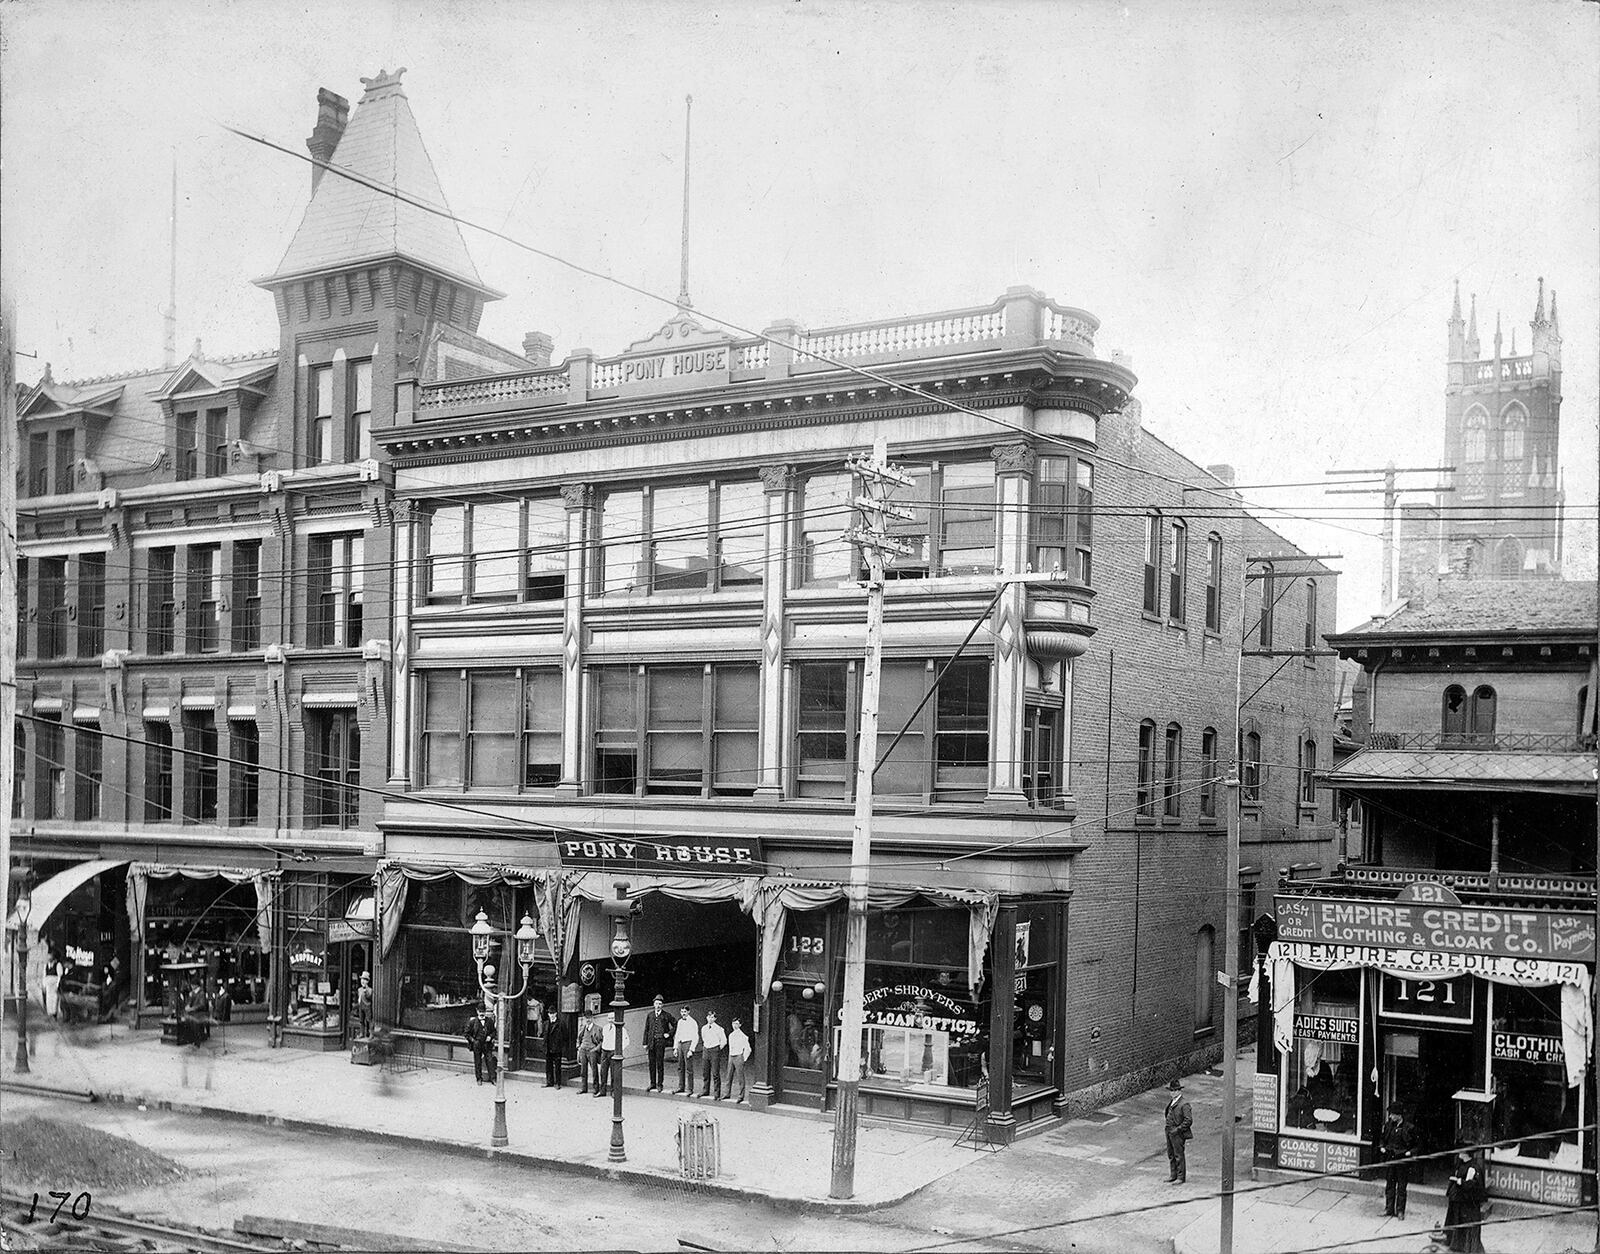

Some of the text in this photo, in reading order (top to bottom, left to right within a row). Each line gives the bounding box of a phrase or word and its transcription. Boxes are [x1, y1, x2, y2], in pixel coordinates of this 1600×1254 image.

[624, 350, 726, 382] PONY HOUSE
[564, 841, 752, 865] PONY HOUSE
[1412, 886, 1444, 902] 121
[1278, 904, 1309, 916] CASH
[1288, 917, 1302, 926] OR
[1322, 904, 1537, 934] EMPIRE CREDIT
[1279, 924, 1313, 938] CREDIT
[1322, 923, 1407, 944] CLOTHING
[1412, 933, 1426, 946] &
[1431, 930, 1493, 950] CLOAK
[791, 936, 824, 953] 123
[1278, 944, 1297, 957] 121
[1310, 944, 1397, 963] EMPIRE
[1410, 952, 1501, 970] CREDIT
[1557, 965, 1580, 979] 121
[862, 987, 889, 1007] BERT
[1397, 979, 1456, 1004] 121
[838, 1008, 871, 1023] CY
[877, 1011, 915, 1027] LOAN
[1293, 1016, 1358, 1033] ADIES SUITS
[1299, 1029, 1315, 1038] EASY
[1318, 1031, 1358, 1042] PAYMENTS.
[1495, 1034, 1563, 1053] CLOTHIN
[1495, 1048, 1520, 1058] CASH
[1526, 1051, 1539, 1060] OR
[1280, 1139, 1319, 1152] CLOAKS
[1327, 1145, 1357, 1157] CASH
[1280, 1154, 1316, 1169] SKIRTS
[1546, 1174, 1576, 1187] CASH
